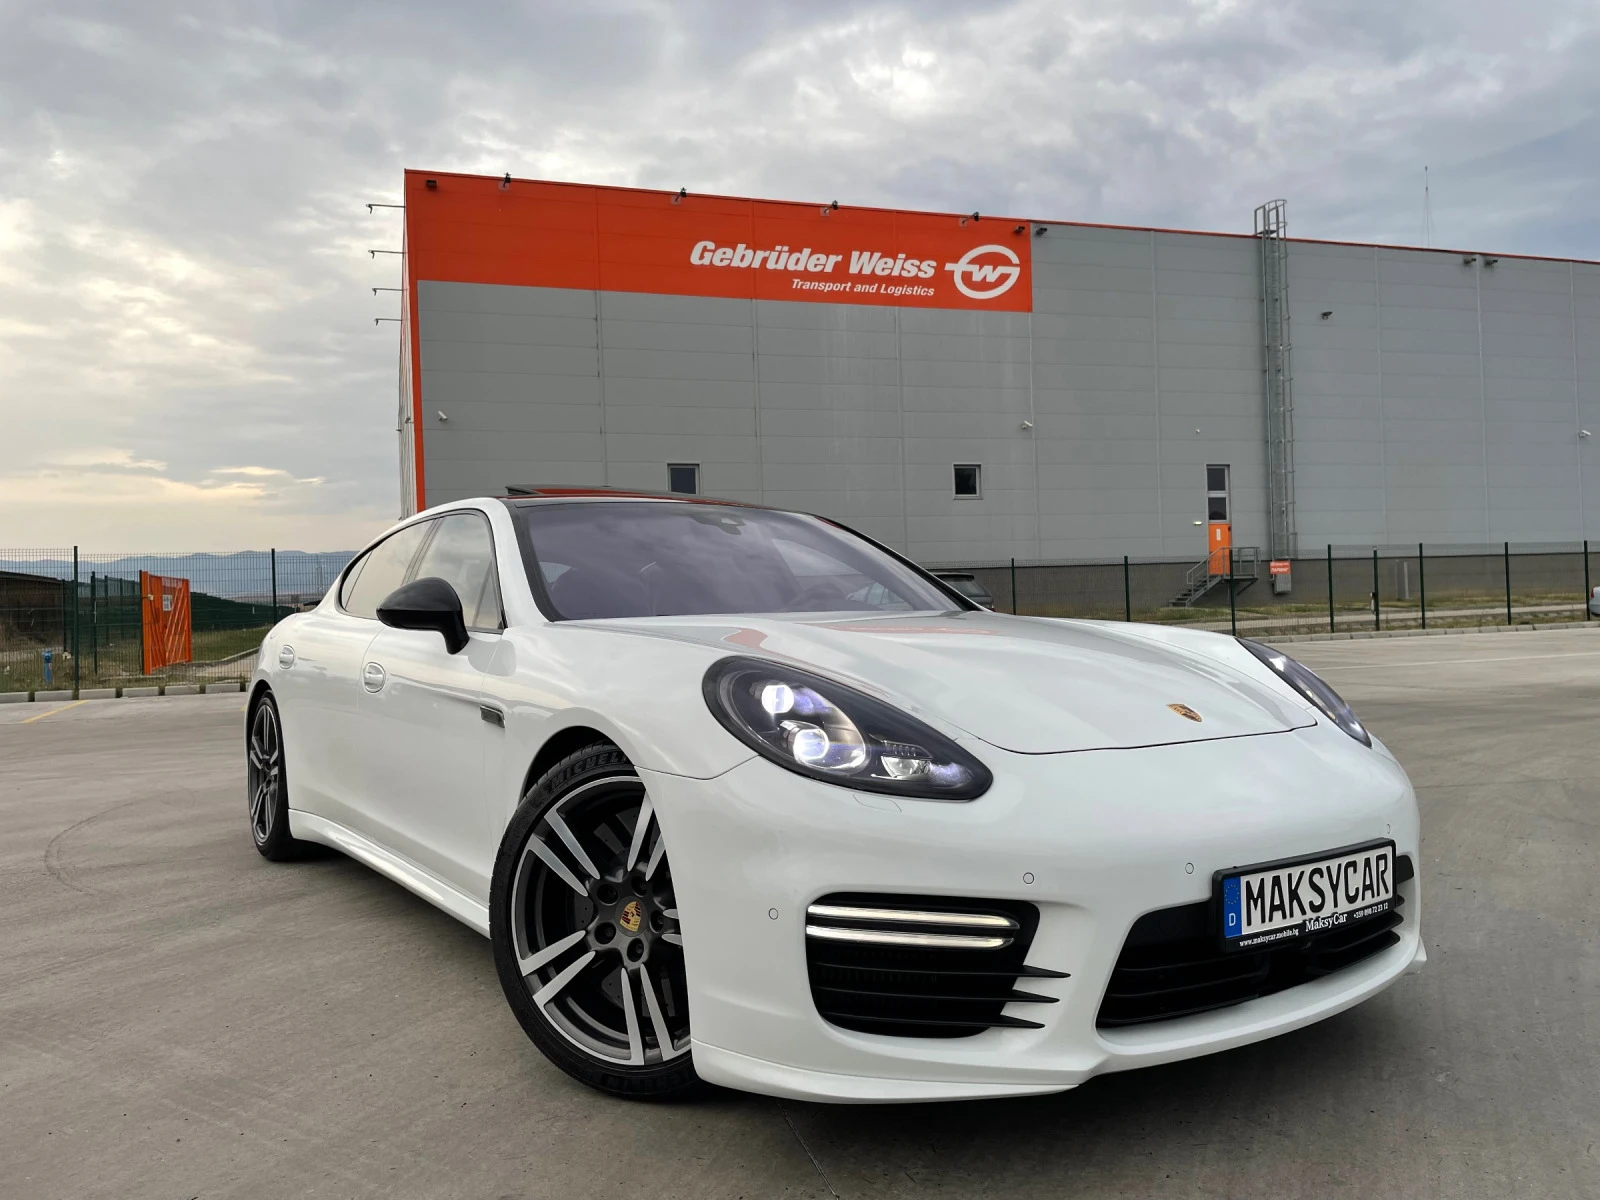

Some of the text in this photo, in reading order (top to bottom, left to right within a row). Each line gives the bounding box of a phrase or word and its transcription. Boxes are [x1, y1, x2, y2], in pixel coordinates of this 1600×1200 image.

[690, 240, 937, 279] Gebrüder Weiss
[792, 278, 935, 297] Transport and Logistics
[1245, 853, 1389, 926] MAKSYCAR
[1228, 912, 1236, 927] D
[1305, 912, 1348, 932] MaksyCar
